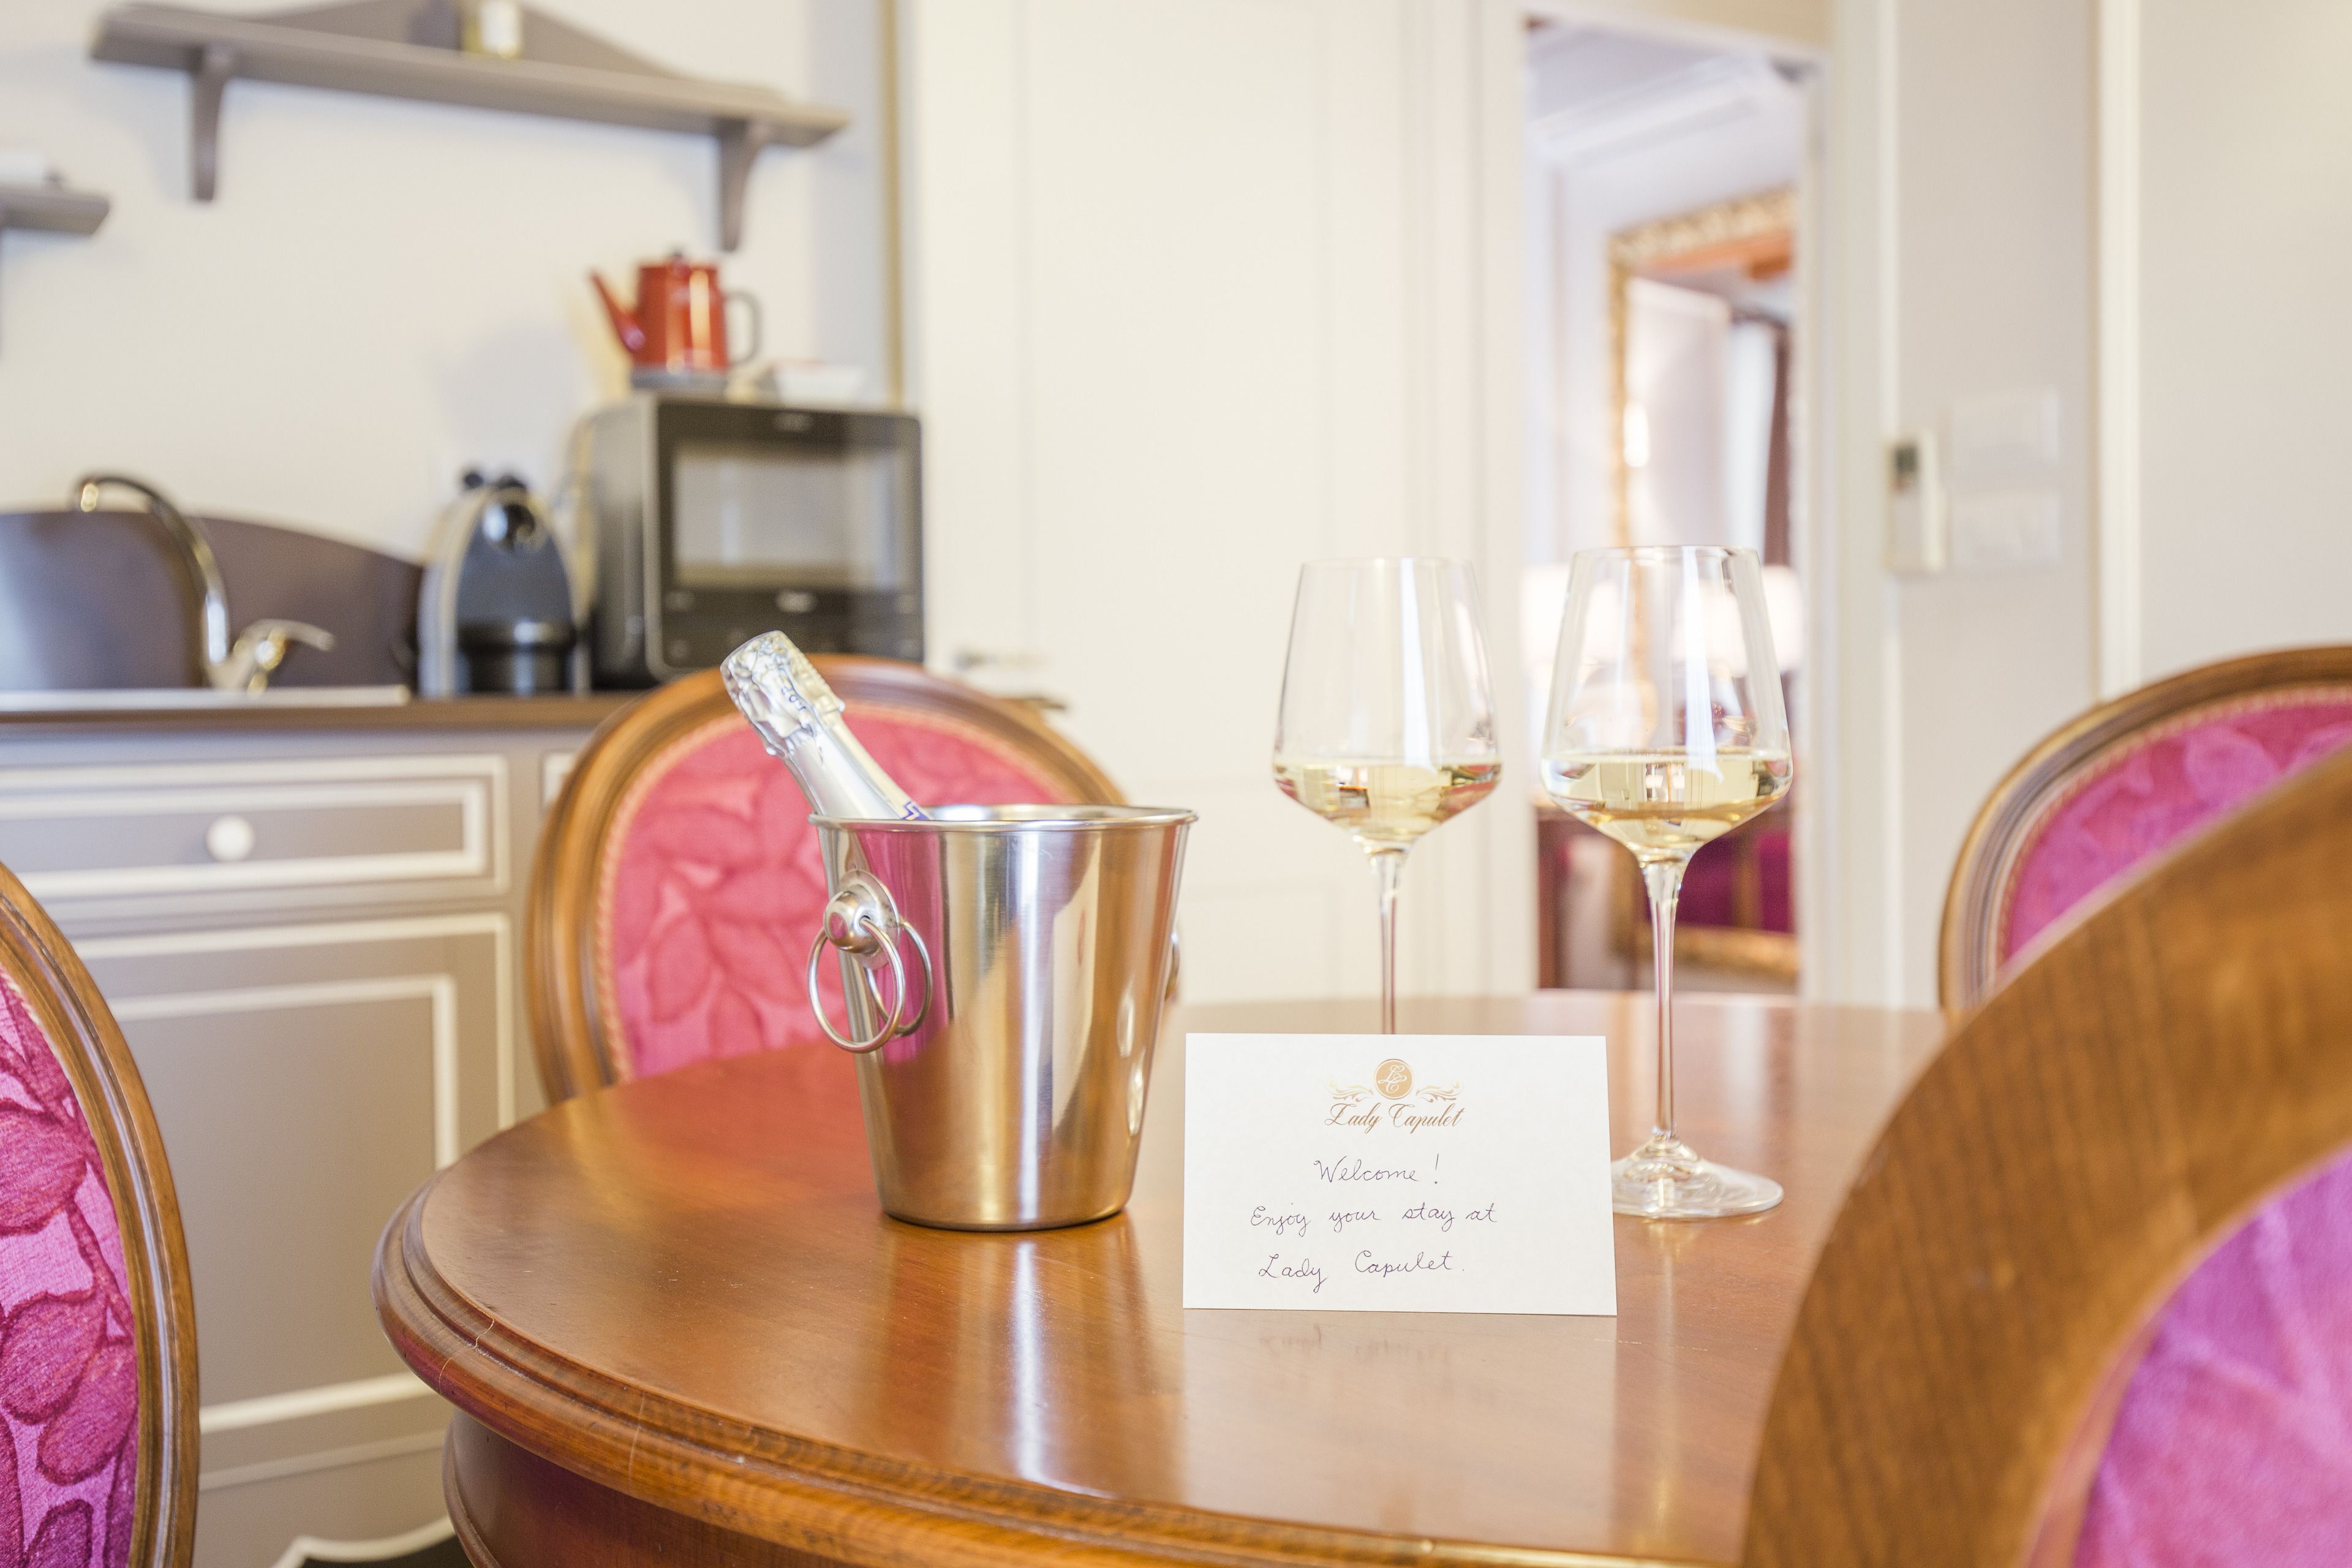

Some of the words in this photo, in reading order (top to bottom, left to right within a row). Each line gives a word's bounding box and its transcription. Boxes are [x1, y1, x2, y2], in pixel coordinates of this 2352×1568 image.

[1324, 1102, 1383, 1134] Lady
[1388, 1102, 1465, 1134] Capulet
[1250, 1202, 1311, 1237] Enjoy
[1328, 1209, 1382, 1233] your
[1401, 1201, 1456, 1232] stay
[1465, 1201, 1498, 1224] at
[1258, 1253, 1328, 1294] Lady
